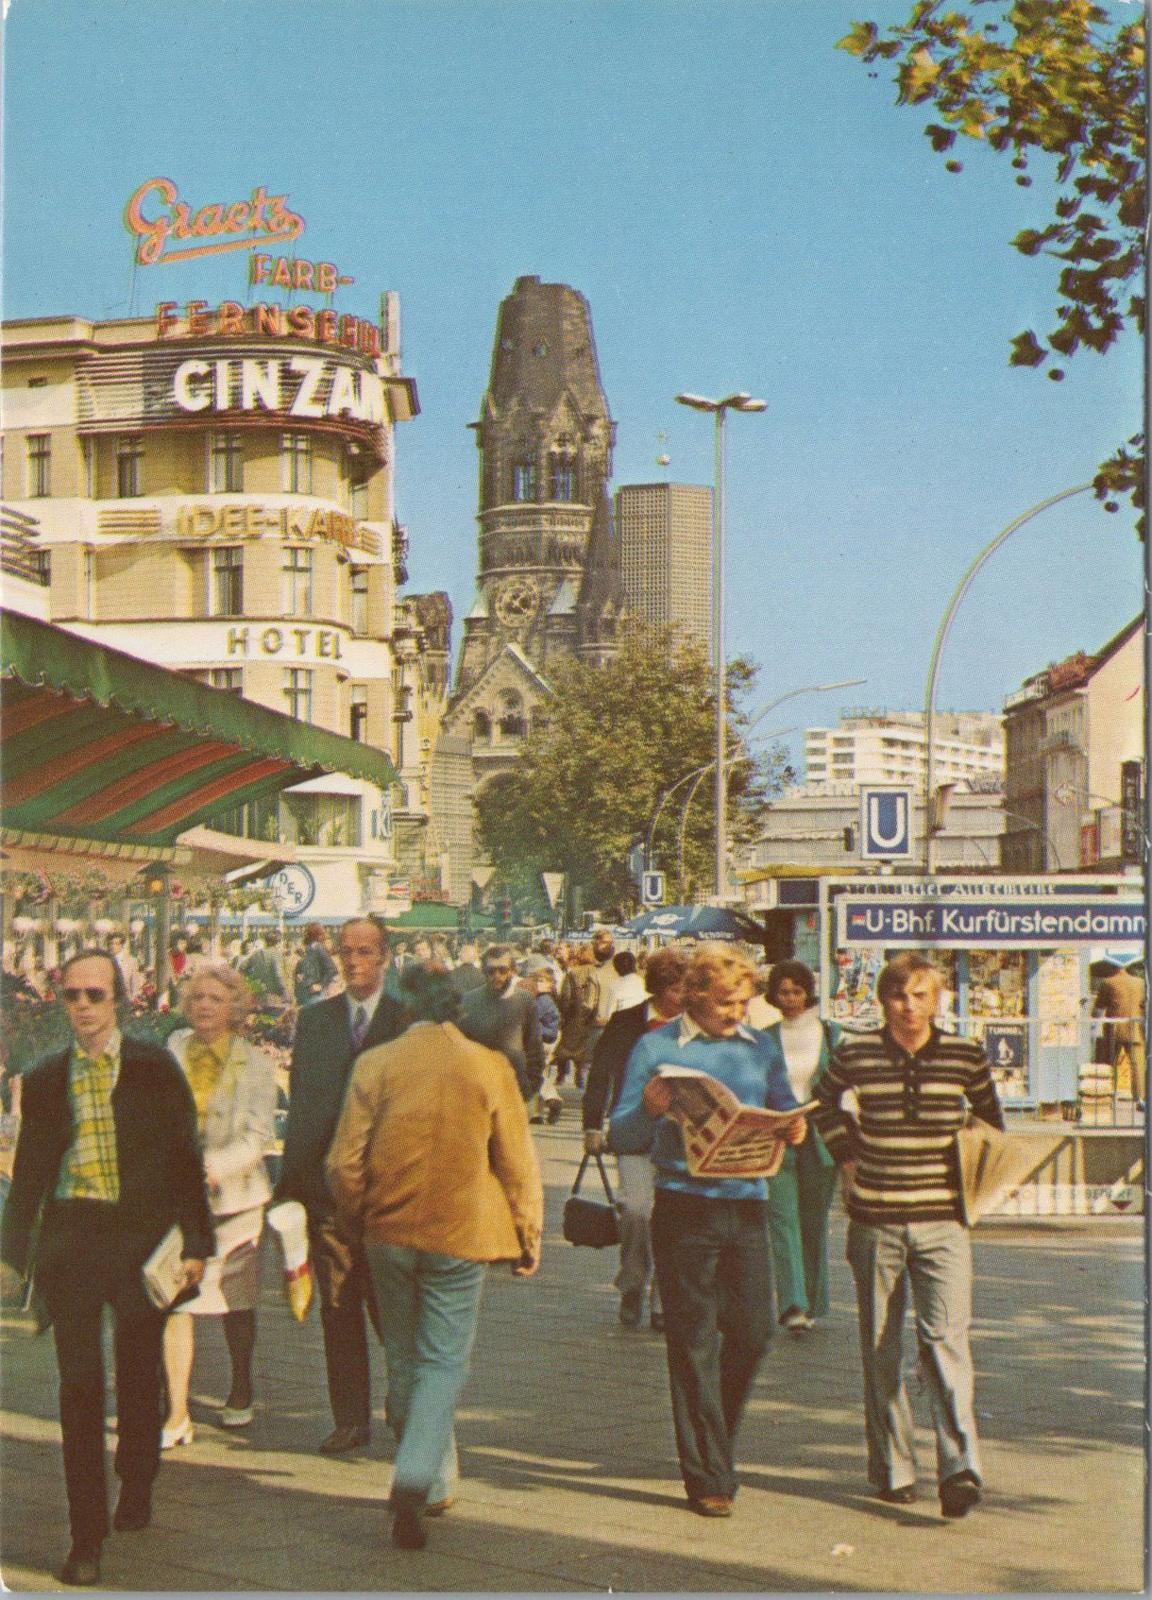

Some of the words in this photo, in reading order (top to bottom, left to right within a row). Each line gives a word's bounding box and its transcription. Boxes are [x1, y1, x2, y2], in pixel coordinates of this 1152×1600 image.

[126, 177, 305, 265] Graetz
[251, 254, 355, 293] FARB-
[227, 627, 343, 660] HOTEL
[870, 796, 905, 848] U
[647, 875, 662, 900] U
